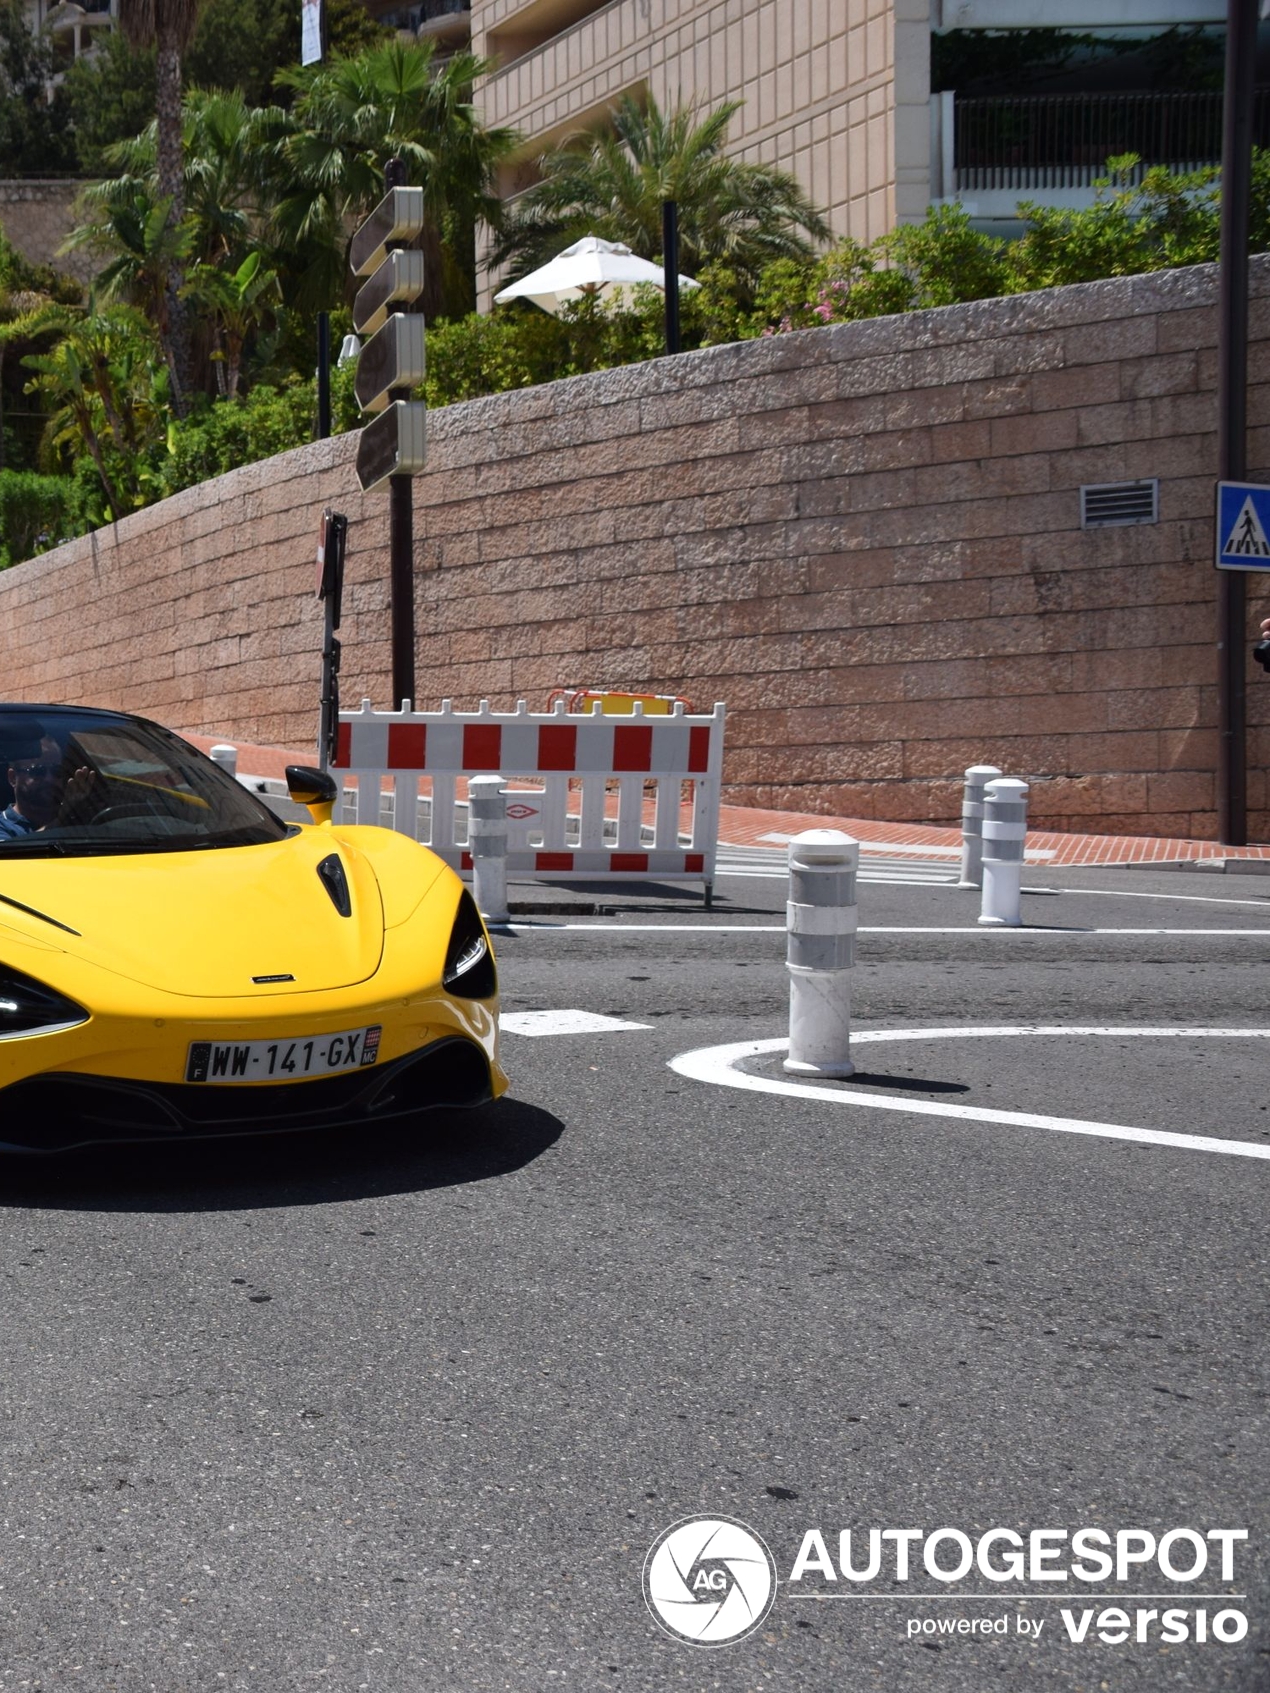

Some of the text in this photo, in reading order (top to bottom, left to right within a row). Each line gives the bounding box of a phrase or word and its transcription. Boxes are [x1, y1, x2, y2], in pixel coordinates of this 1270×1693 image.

[212, 1034, 360, 1076] WW-141-GX
[362, 1050, 377, 1063] MC
[194, 1069, 203, 1078] F
